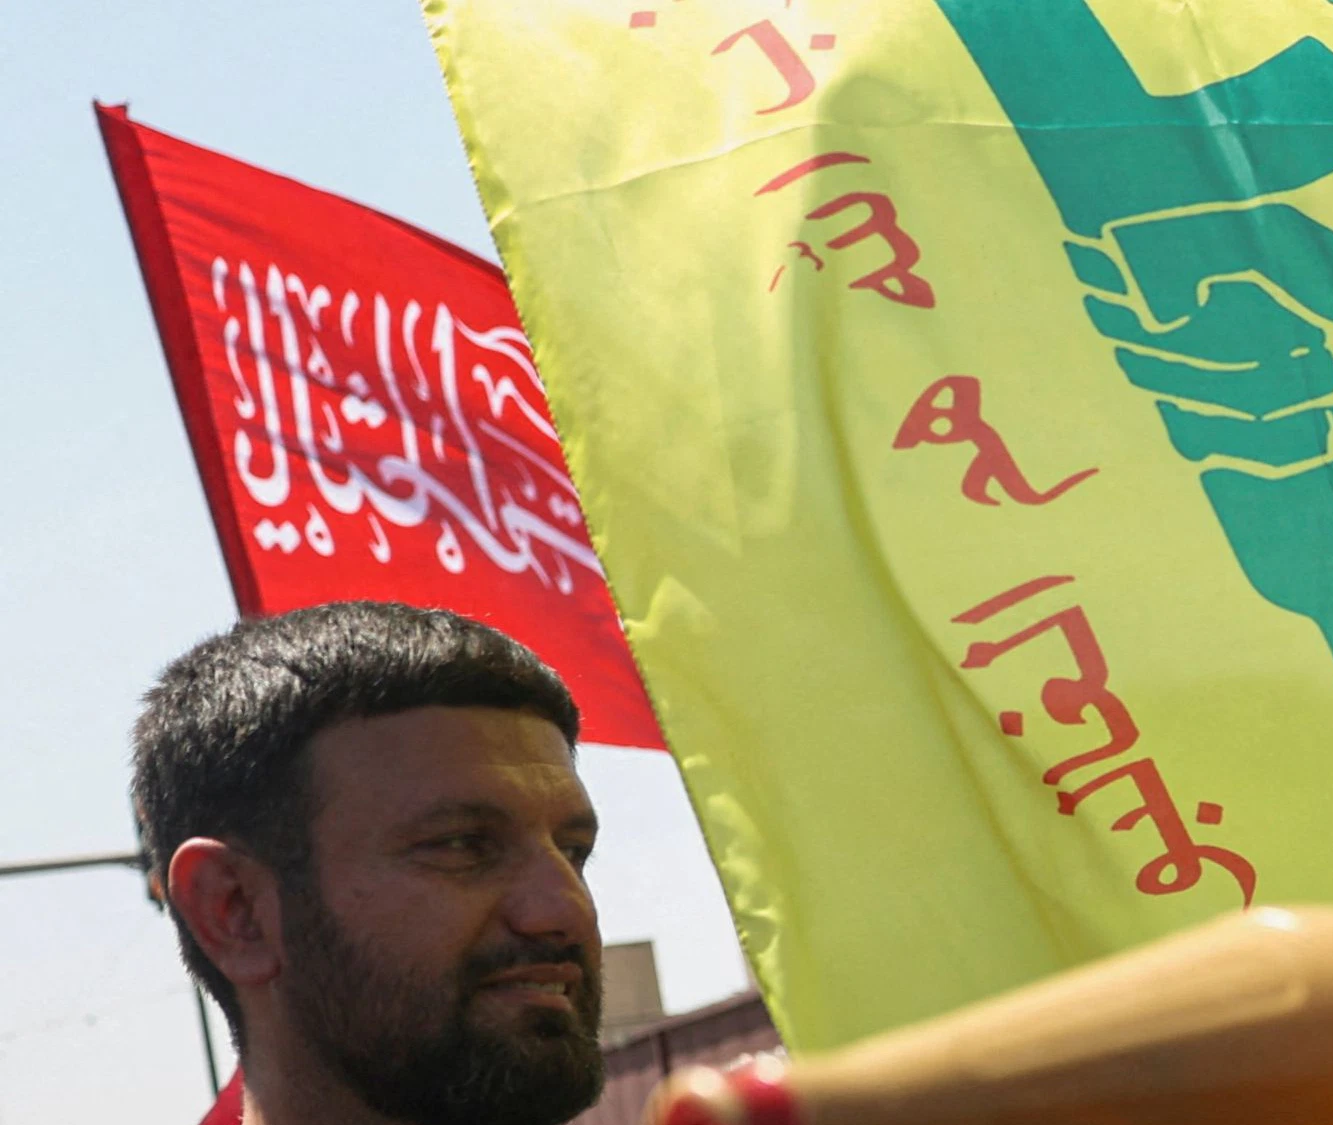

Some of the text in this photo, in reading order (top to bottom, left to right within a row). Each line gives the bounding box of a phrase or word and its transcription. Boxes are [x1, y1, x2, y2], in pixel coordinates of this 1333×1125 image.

[753, 151, 1258, 911] الله هم الغالبو
